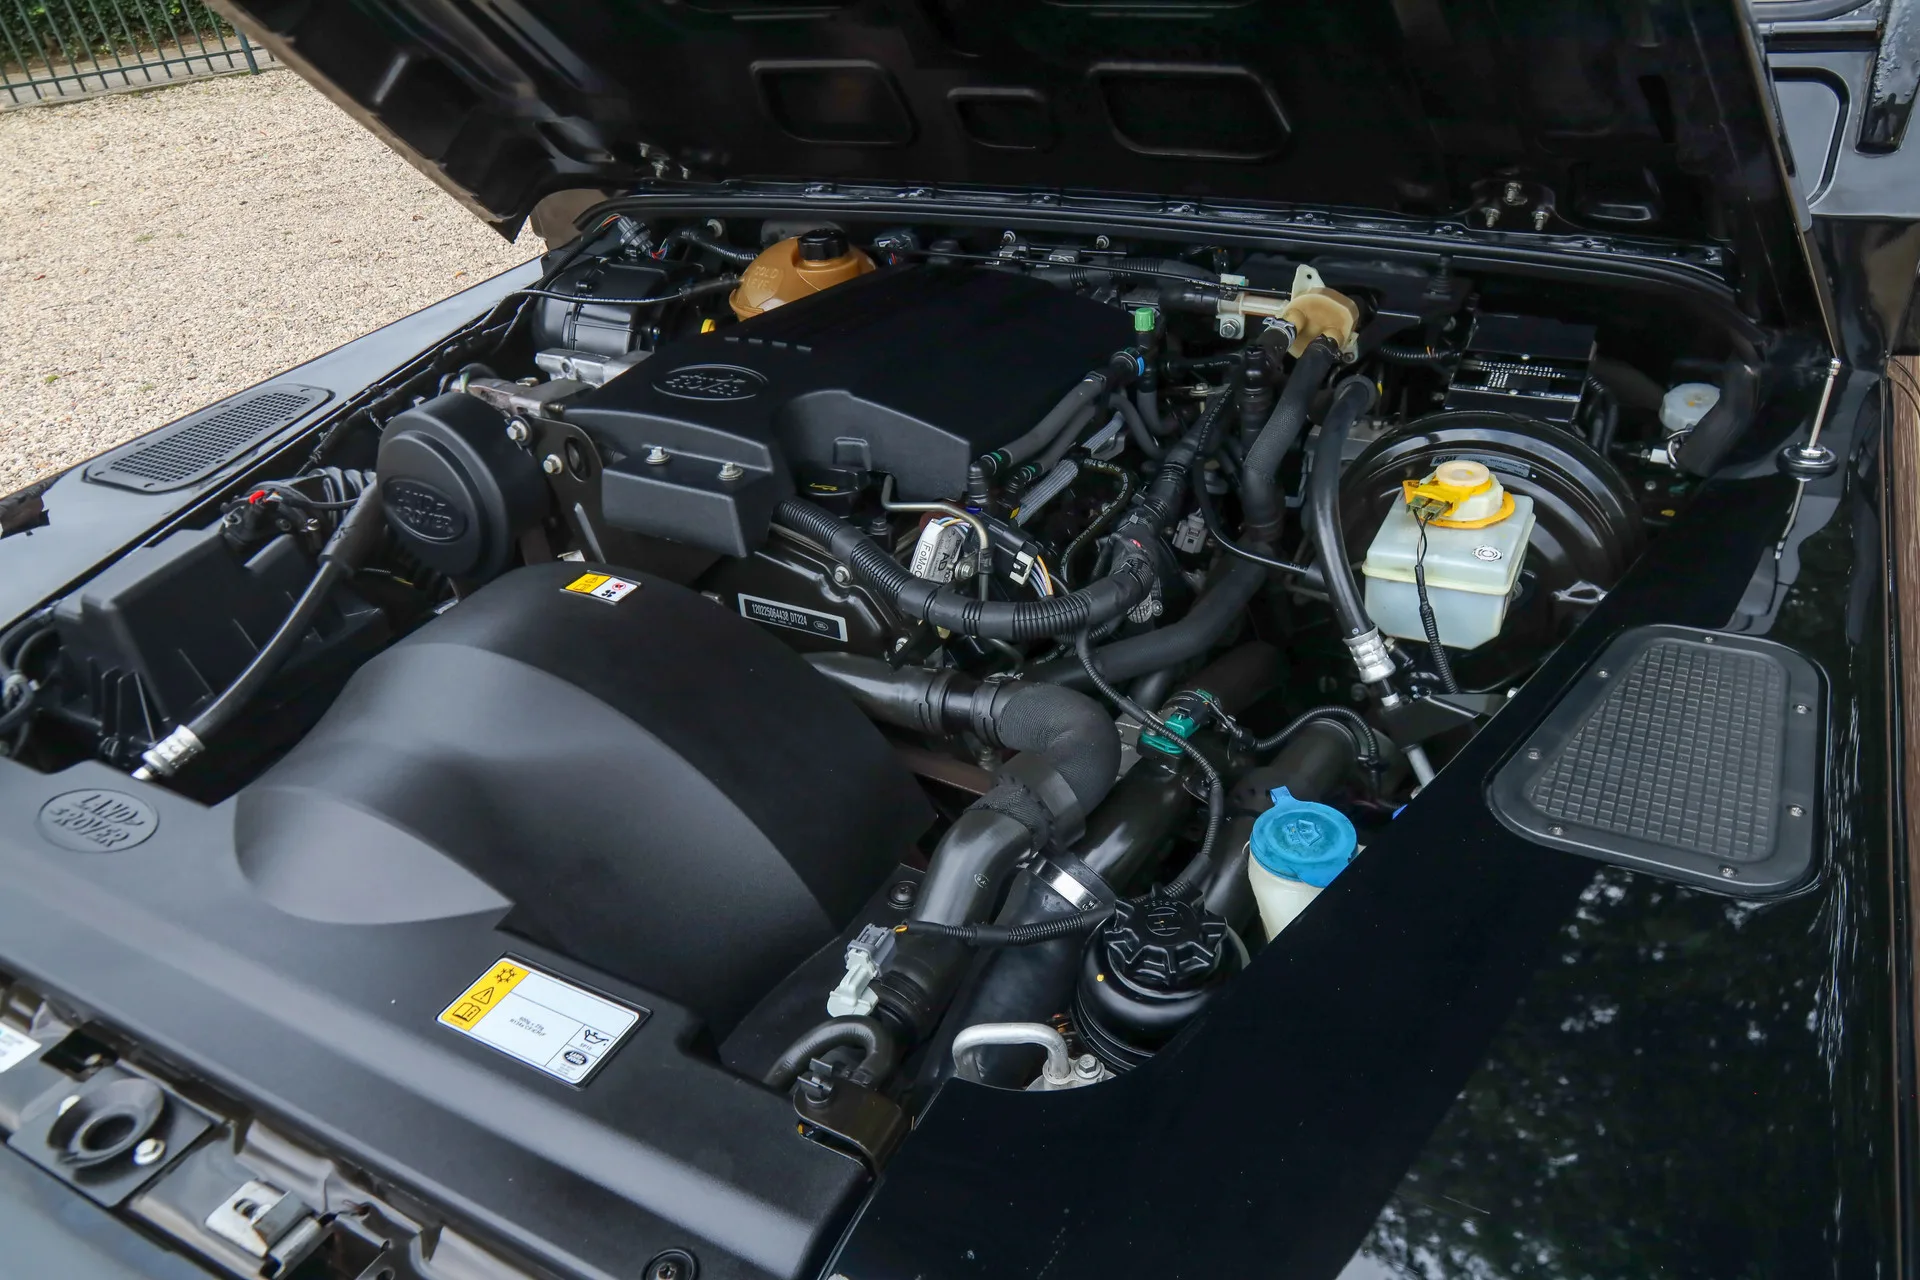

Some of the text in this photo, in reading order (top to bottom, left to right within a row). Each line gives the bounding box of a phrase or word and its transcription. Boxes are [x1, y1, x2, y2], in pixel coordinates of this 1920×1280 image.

[754, 266, 780, 279] COLD
[789, 612, 808, 626] DT224
[73, 794, 139, 823] LAND
[53, 810, 131, 848] ROVER
